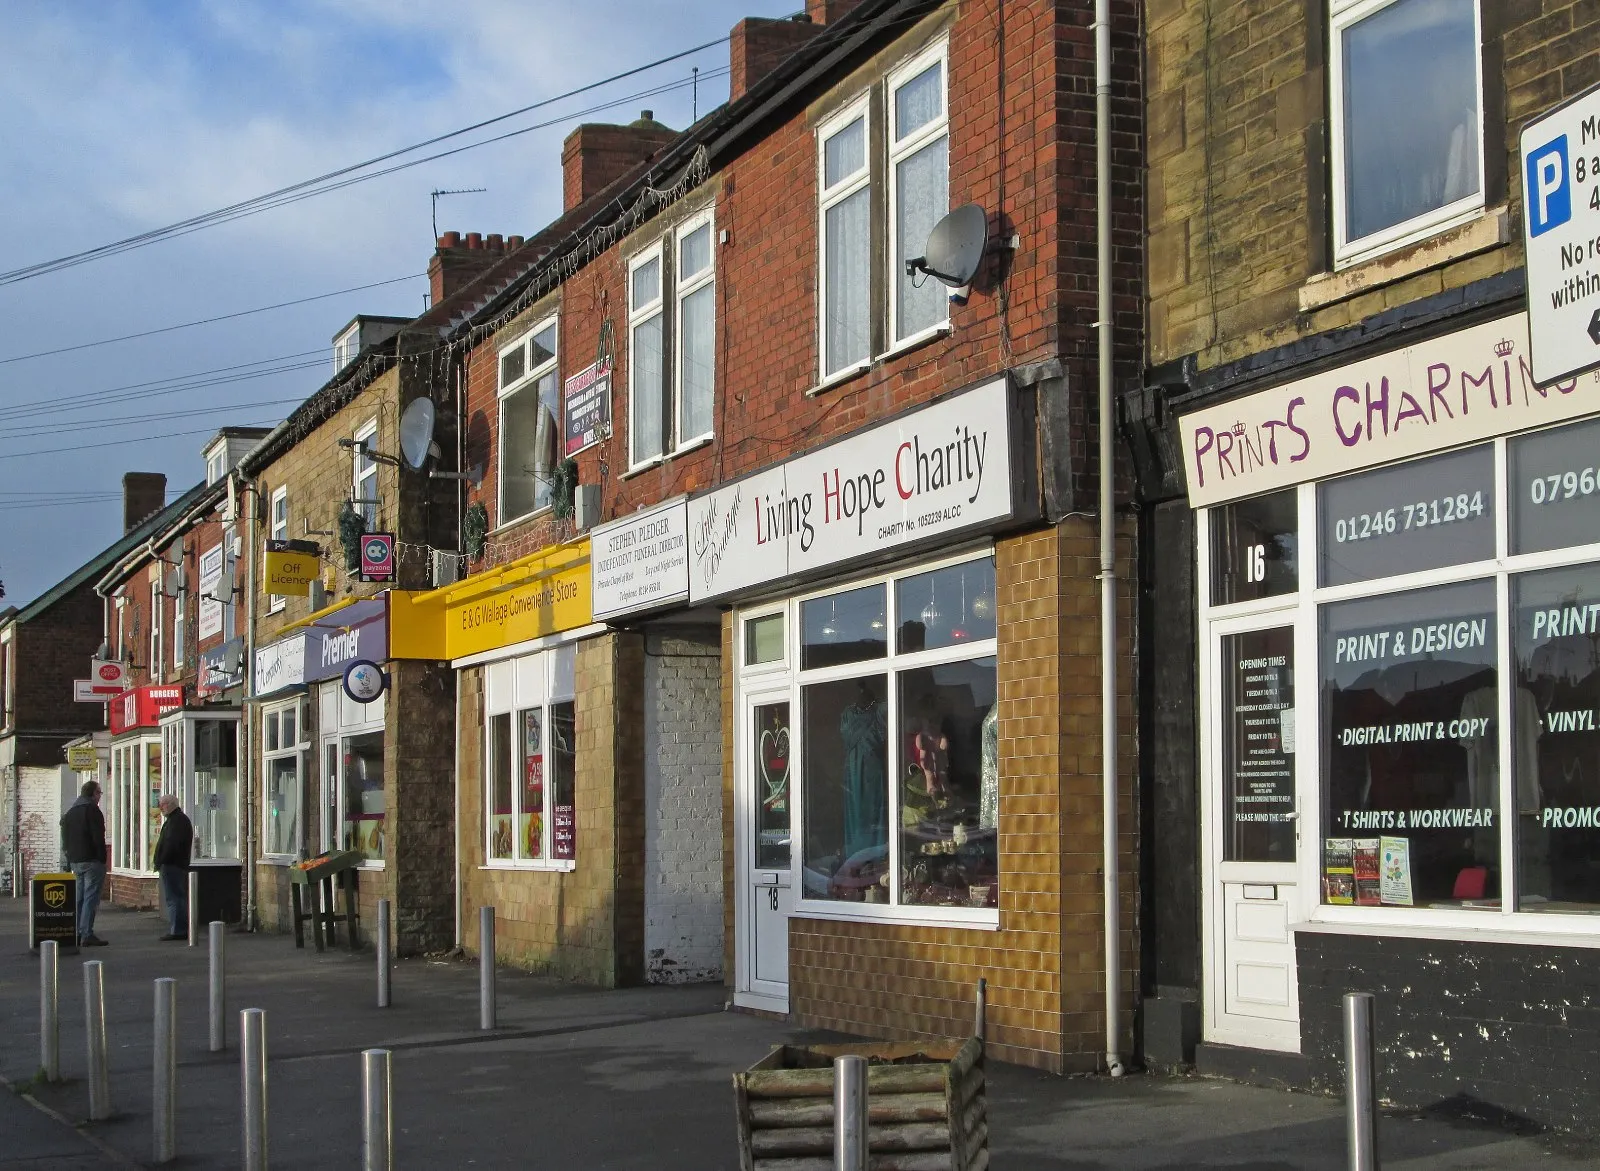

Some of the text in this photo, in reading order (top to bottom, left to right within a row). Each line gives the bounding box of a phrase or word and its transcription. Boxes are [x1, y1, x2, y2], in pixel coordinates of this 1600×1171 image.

[1581, 115, 1600, 145] M
[1575, 156, 1587, 183] 8
[1561, 242, 1583, 271] No
[1195, 354, 1578, 488] PRINTS CHARMIN
[755, 425, 987, 553] Living Hope Charity
[1531, 467, 1600, 504] 0796
[878, 504, 962, 540] CHARITY No. 1052239 ALCC
[1335, 490, 1484, 543] 01246 731284
[608, 517, 670, 553] STEPHEN PLEDGER
[283, 563, 301, 574] Off
[597, 534, 684, 574] INDEPENDENT FUNERAL DIRECTOR
[1247, 543, 1266, 584] 16
[364, 565, 391, 573] payzone
[462, 610, 467, 630] E
[468, 608, 474, 628] &
[474, 606, 480, 626] G
[556, 579, 578, 603] Store
[1532, 603, 1600, 640] PRINT
[321, 628, 360, 668] Premier
[1335, 618, 1487, 664] PRINT & DESIGN
[1240, 655, 1286, 670] OPENING TIMES
[149, 689, 179, 698] BURGERS
[1235, 704, 1258, 712] WEDNESDAY
[1258, 703, 1273, 711] CLOSED
[1246, 689, 1263, 697] TUESDAY
[1245, 718, 1265, 726] THURSDAY
[1342, 717, 1490, 746] DIGITAL PRINT & COPY
[1547, 709, 1596, 733] VINYL
[1247, 733, 1262, 741] FRIDAY
[1235, 813, 1254, 822] PLEASE
[1254, 813, 1269, 822] MIND
[1269, 813, 1279, 822] THE
[1343, 808, 1493, 829] T SHIRTS & WORKWEAR
[46, 890, 64, 905] ups
[767, 887, 779, 911] 18
